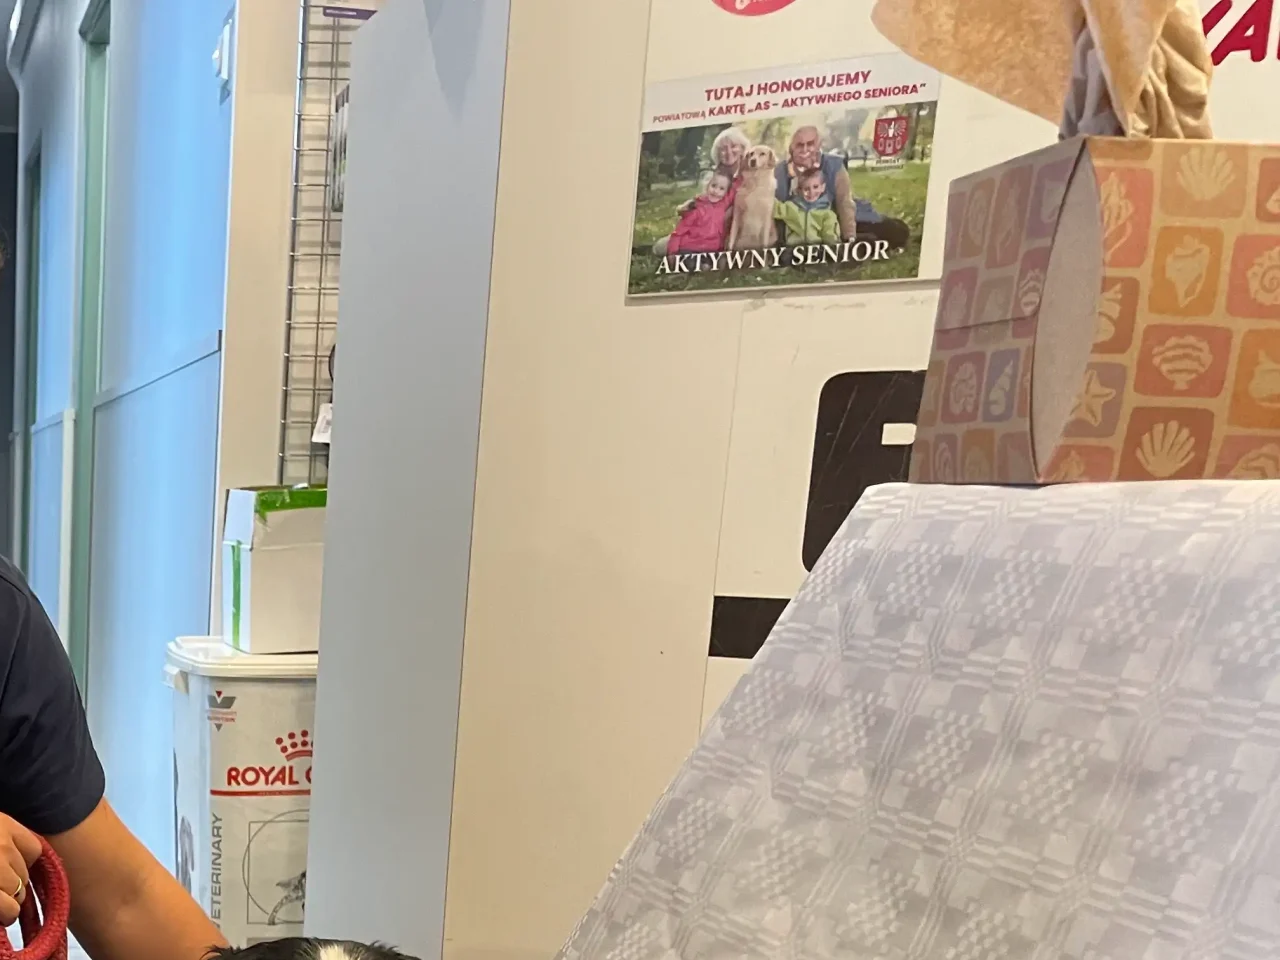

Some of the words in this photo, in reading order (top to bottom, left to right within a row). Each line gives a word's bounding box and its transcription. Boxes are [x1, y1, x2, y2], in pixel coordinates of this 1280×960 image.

[705, 84, 754, 101] TUTAJ
[756, 70, 872, 96] HONORUJEMY
[652, 110, 706, 123] POWIATOWĄ
[708, 103, 746, 117] KARTĘ
[781, 91, 862, 109] AKTYWNEGO
[655, 247, 787, 275] AKTYWNY
[791, 240, 890, 266] SENIOR
[226, 765, 299, 786] ROYAL
